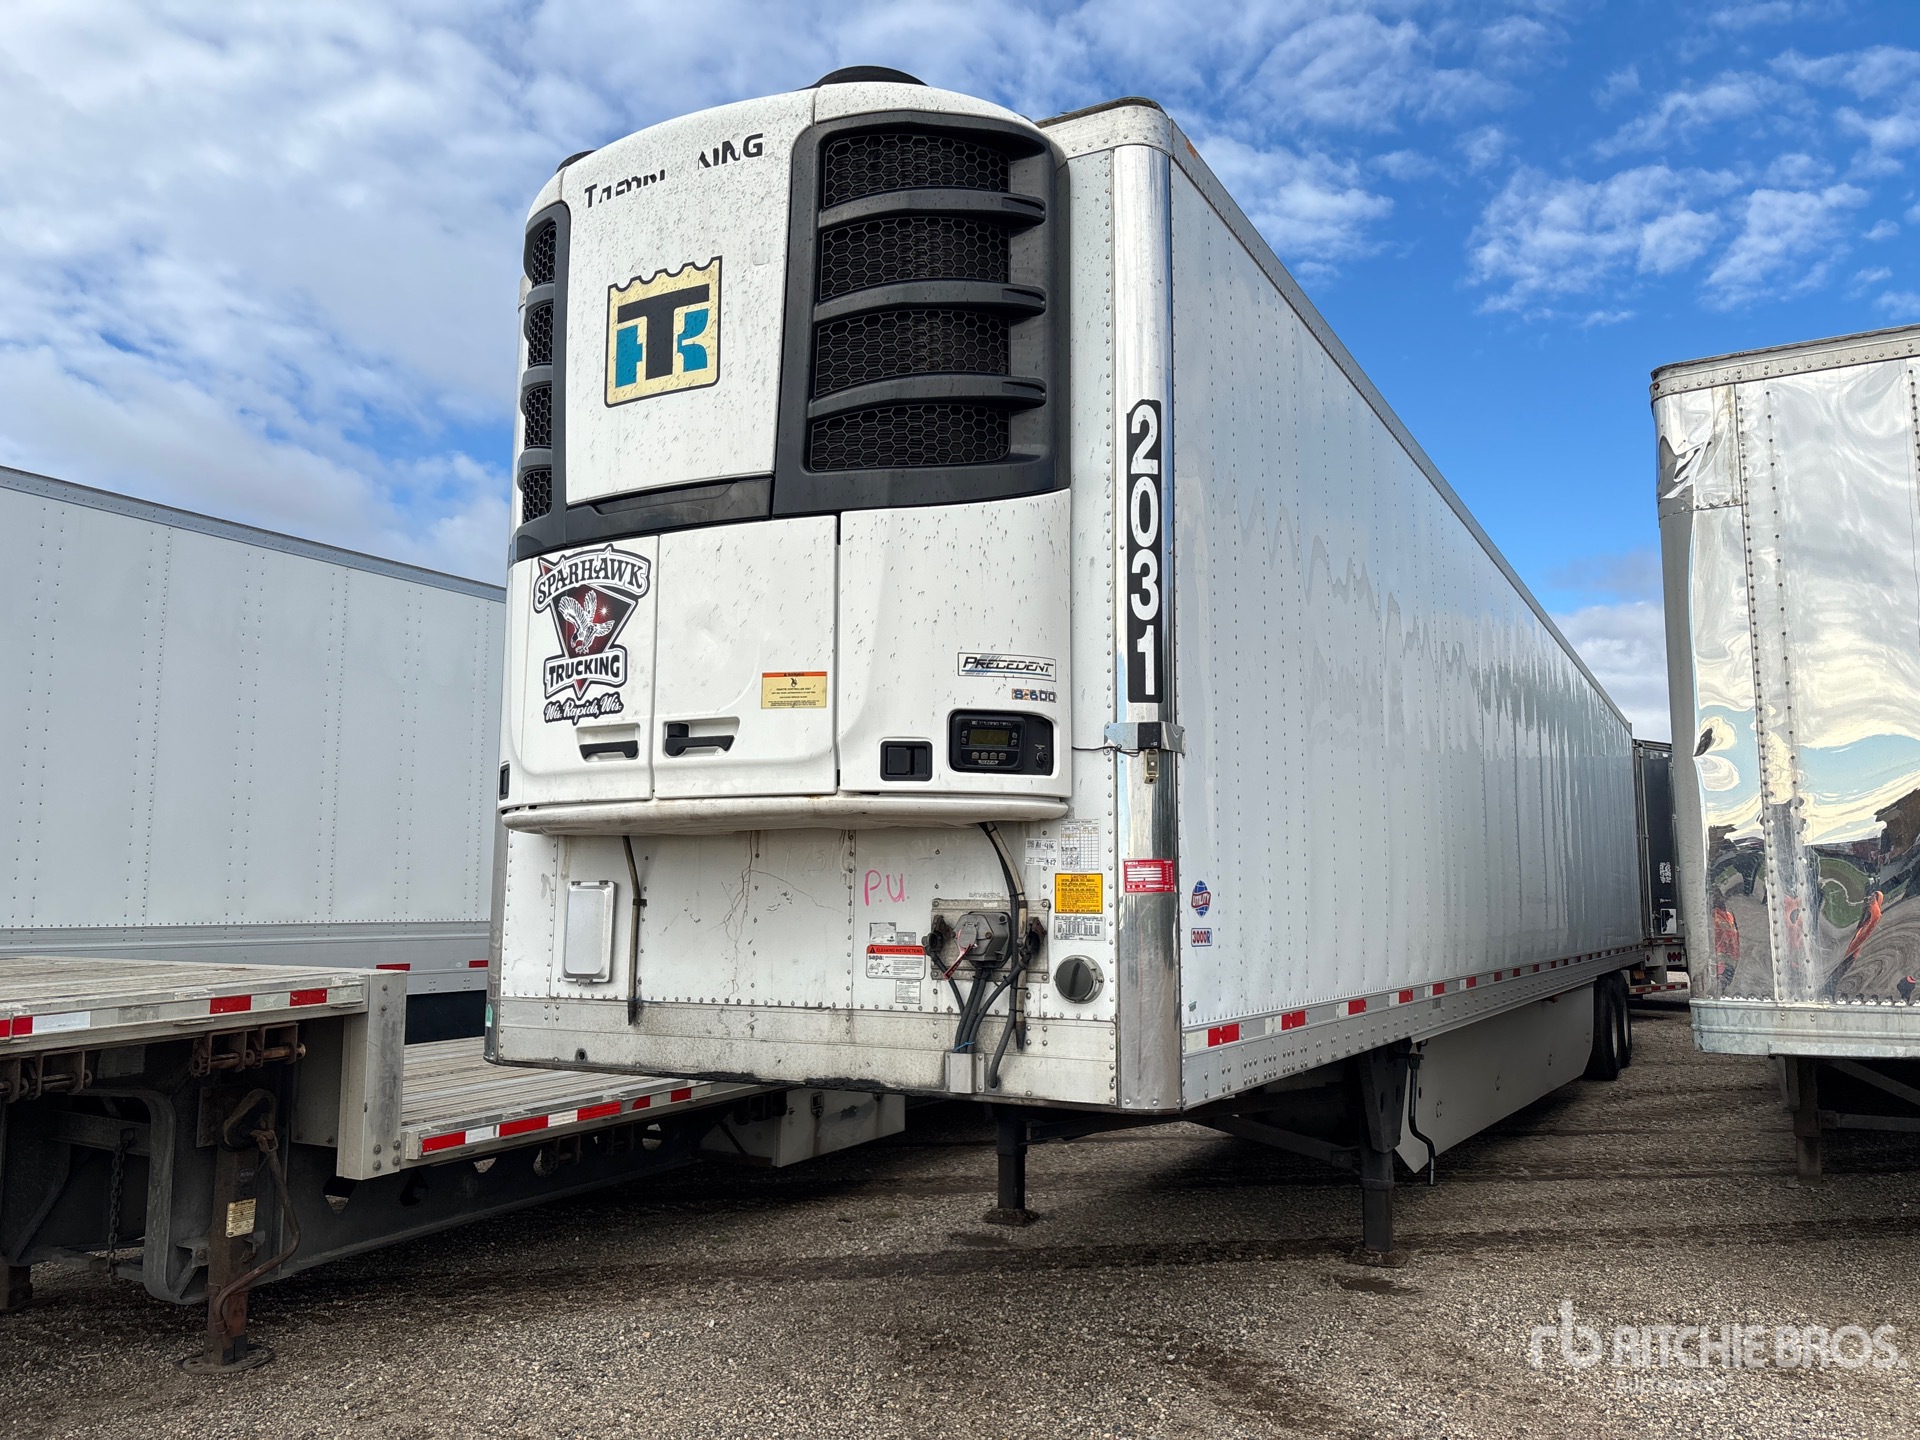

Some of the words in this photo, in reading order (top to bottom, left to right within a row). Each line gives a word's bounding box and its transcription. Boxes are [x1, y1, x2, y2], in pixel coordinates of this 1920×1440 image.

[1130, 404, 1160, 696] 2031
[538, 556, 643, 604] SPARHAWK
[548, 654, 620, 688] TRUCKING
[962, 656, 1054, 673] PRECEDENT
[1192, 930, 1211, 944] 3000R
